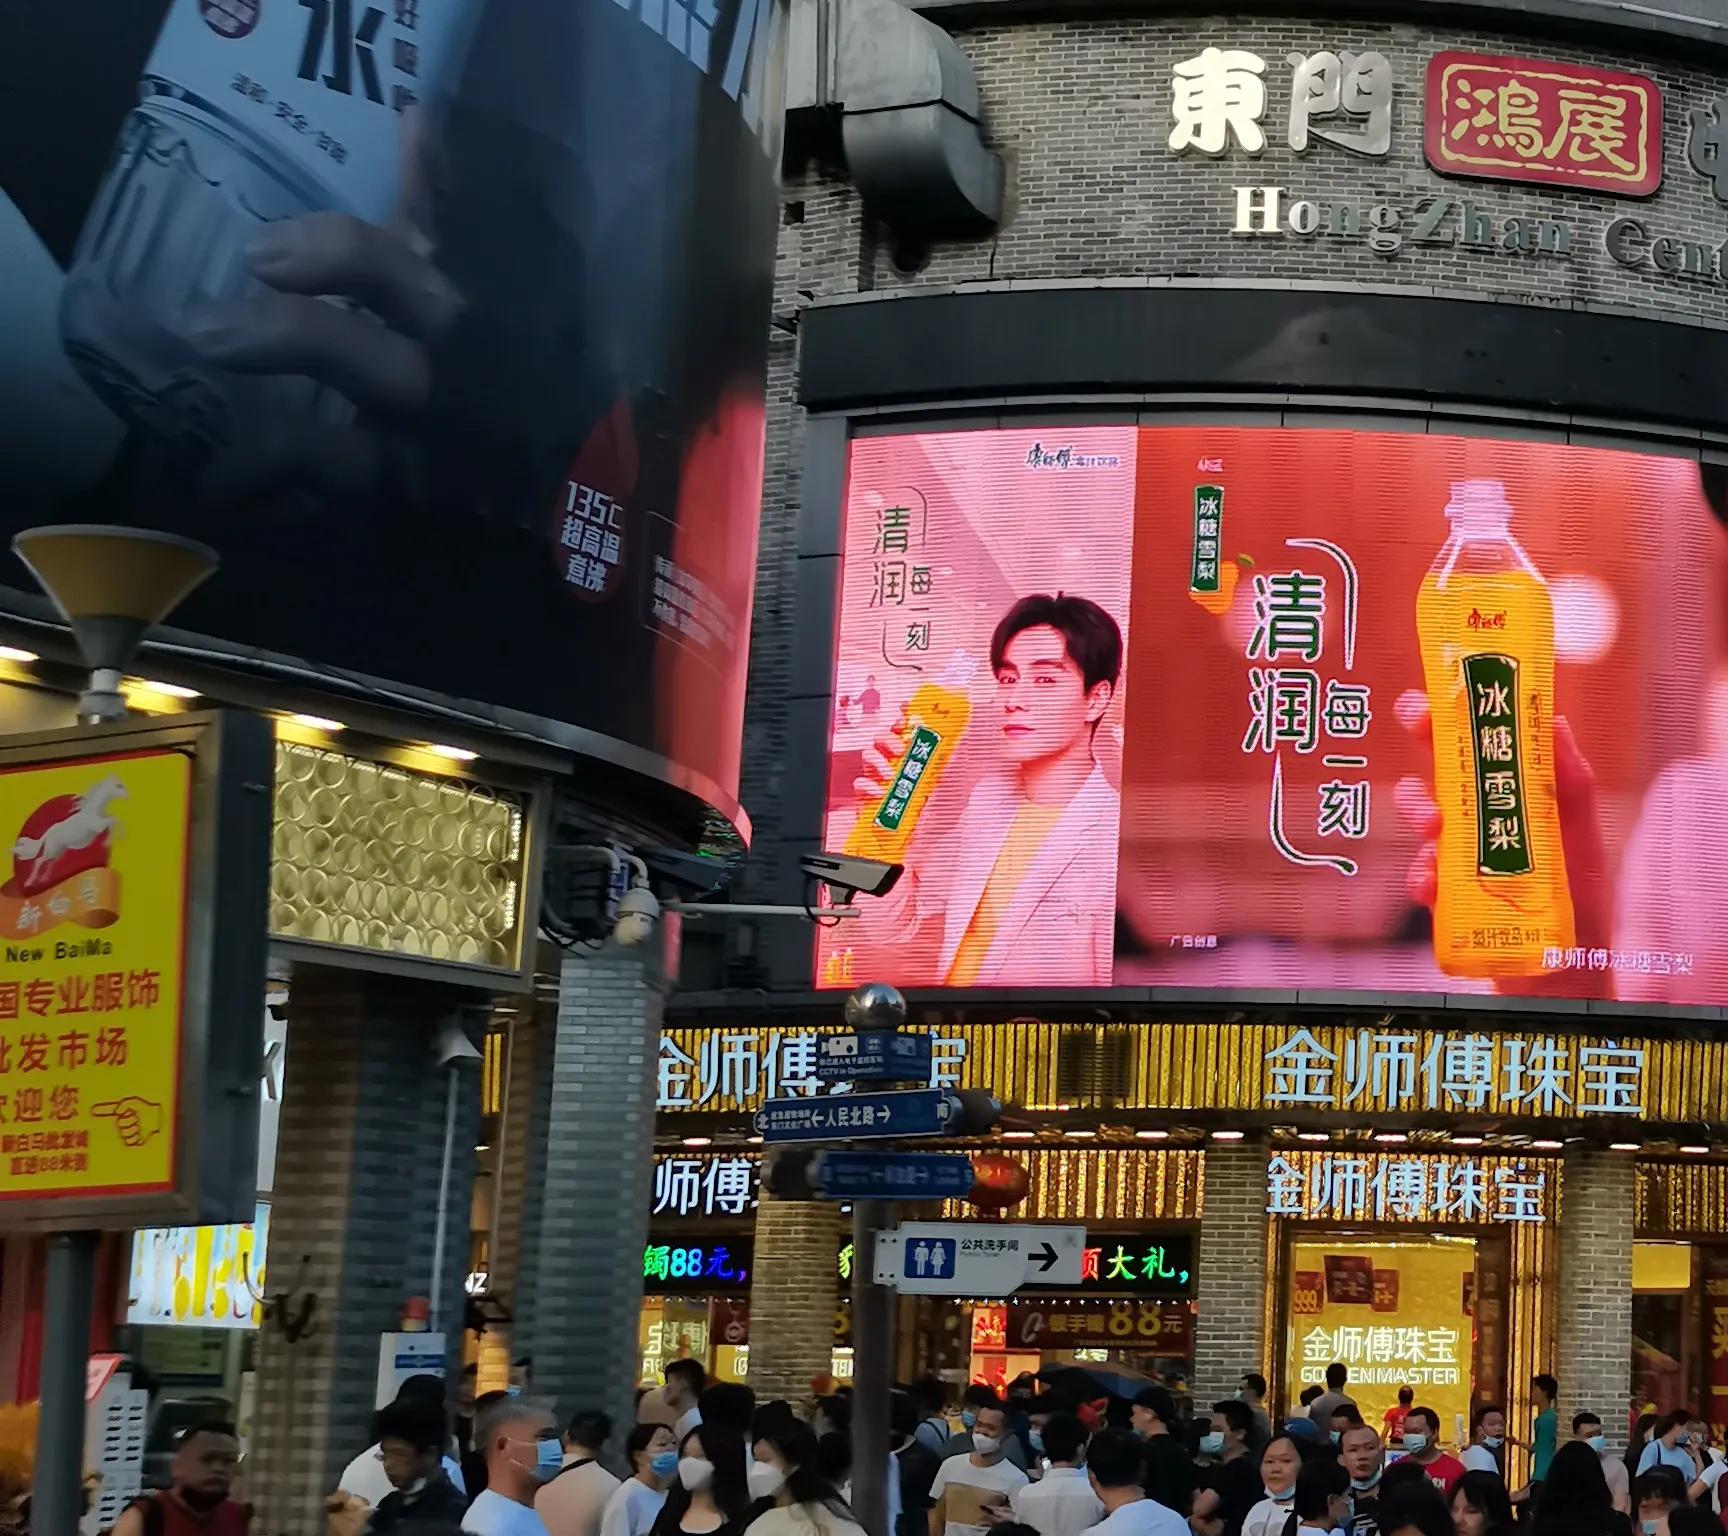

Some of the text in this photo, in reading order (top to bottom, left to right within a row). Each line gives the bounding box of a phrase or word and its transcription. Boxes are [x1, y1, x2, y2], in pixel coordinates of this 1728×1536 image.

[1168, 47, 1395, 158] 東門
[1231, 185, 1574, 257] HongZhan
[559, 514, 622, 565] 超高温
[869, 504, 912, 609] 清润
[904, 565, 934, 652] 每一刻
[1242, 569, 1329, 754] 清润
[1316, 680, 1372, 839] 每一刻
[1476, 679, 1522, 851] 冰糖雪梨
[6, 938, 113, 963] New BaiMa
[1263, 1027, 1646, 1117] 金师傅珠宝
[825, 1105, 875, 1127] 人民北路
[653, 1157, 762, 1216] 师傅
[1265, 1155, 1548, 1223] 金师傅珠宝
[959, 1238, 1021, 1253] 公共洗手间
[1300, 1366, 1461, 1386] GOEN MASTER
[1301, 1324, 1460, 1364] 金师傅珠宝
